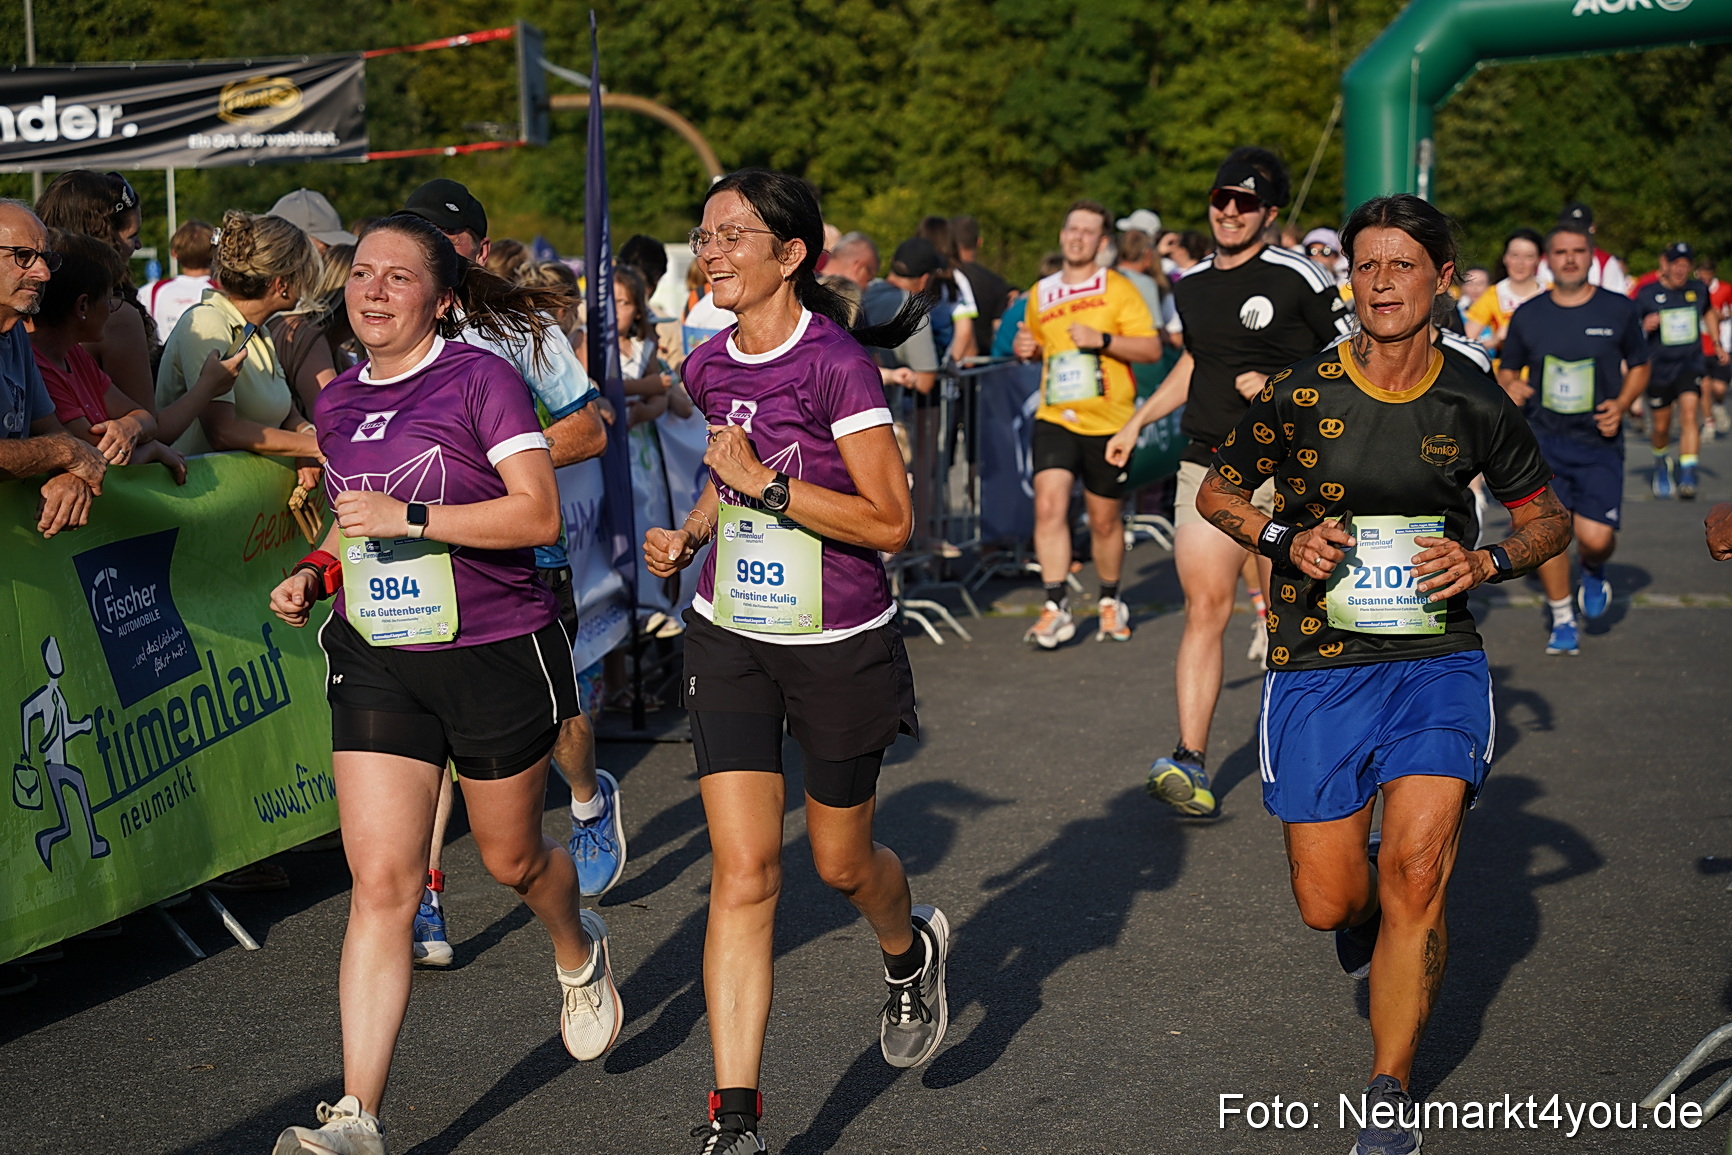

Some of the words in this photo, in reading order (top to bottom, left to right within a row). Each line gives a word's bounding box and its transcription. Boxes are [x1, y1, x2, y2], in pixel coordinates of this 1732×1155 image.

[188, 133, 211, 149] Ein
[240, 132, 265, 148] der
[736, 531, 764, 540] Firmenlauf
[736, 558, 785, 587] 993
[1353, 565, 1416, 590] 2107
[369, 575, 421, 601] 984
[730, 588, 768, 603] Christine
[769, 593, 797, 606] Kulig
[1347, 595, 1394, 606] Susanne
[104, 583, 157, 624] Fischer
[360, 608, 377, 618] Eva
[378, 604, 442, 618] Guttenberger
[118, 608, 161, 638] AUTOMOBILE
[146, 640, 160, 655] das
[94, 621, 292, 797] firmenlauf
[119, 764, 197, 839] neumarkt
